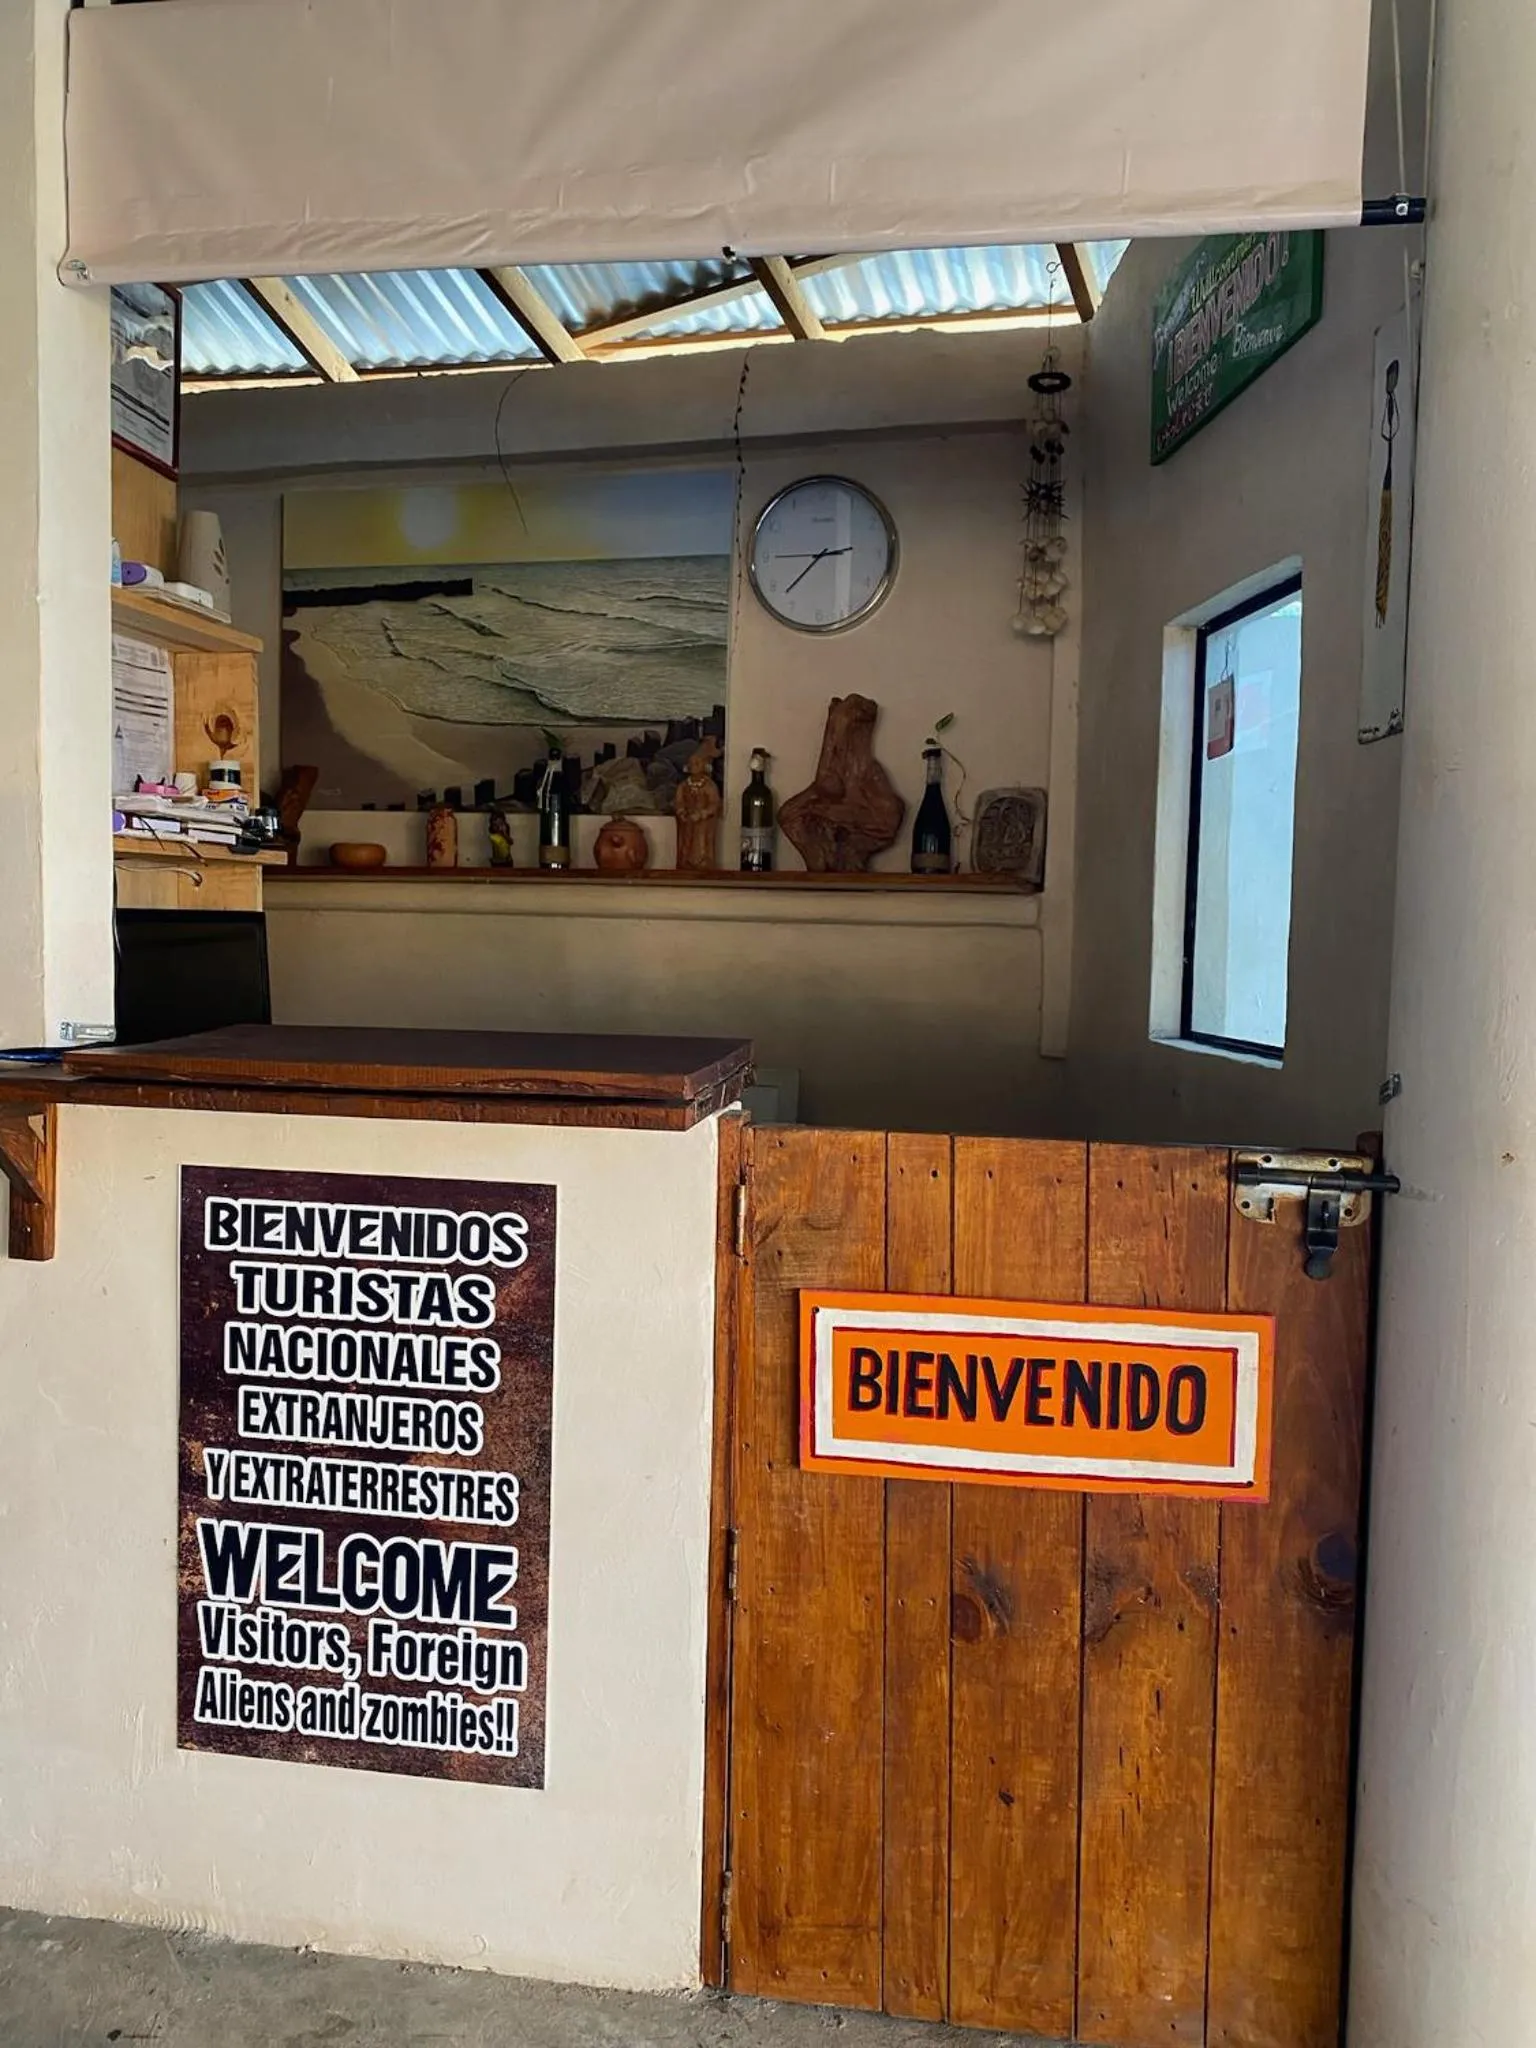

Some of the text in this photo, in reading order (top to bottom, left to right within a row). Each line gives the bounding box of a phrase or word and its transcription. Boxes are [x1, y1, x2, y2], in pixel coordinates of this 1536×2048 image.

[208, 1200, 525, 1265] BIENVENIDOS
[234, 1264, 492, 1325] TURISTAS
[228, 1325, 497, 1389] NACIONALES
[847, 1346, 1208, 1435] BIENVENIDO
[242, 1389, 479, 1452] EXTRANJEROS
[200, 1521, 515, 1626] WELCOME
[200, 1604, 523, 1688] Visitors, Foreign
[198, 1670, 515, 1753] Aliens and zombies!!
